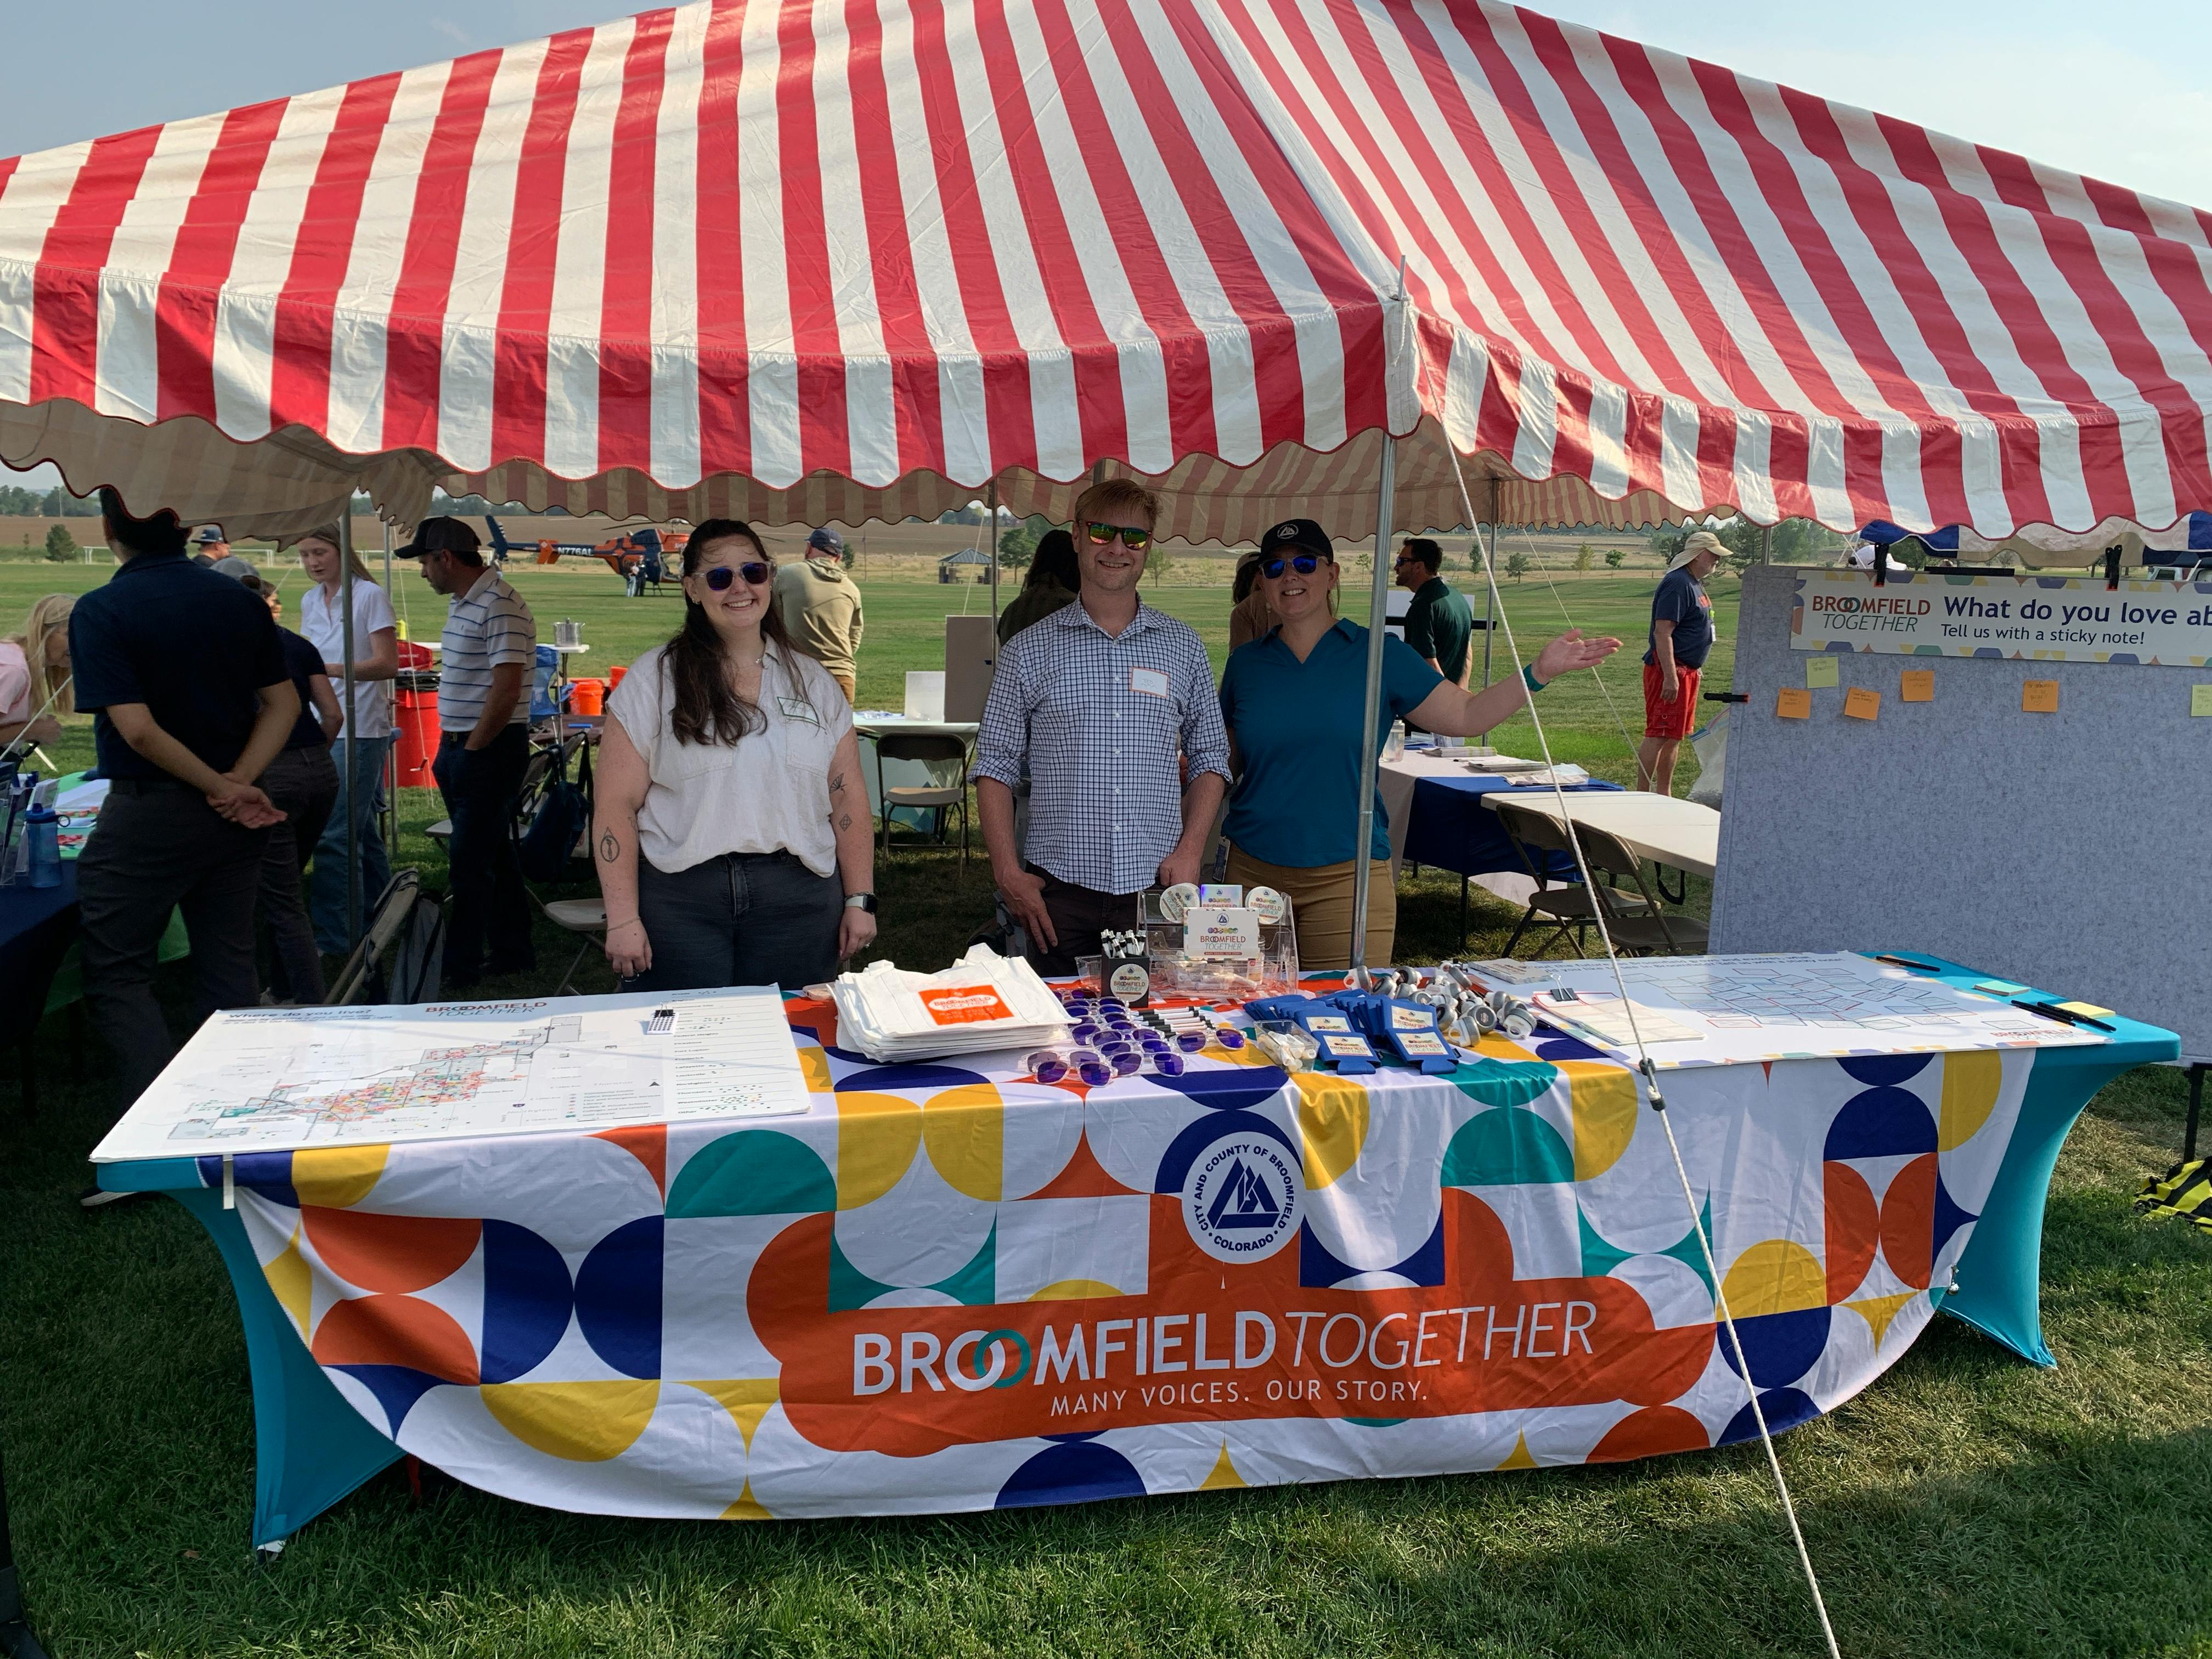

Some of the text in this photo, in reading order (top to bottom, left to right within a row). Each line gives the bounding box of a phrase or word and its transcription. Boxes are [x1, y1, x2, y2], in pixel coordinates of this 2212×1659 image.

[557, 546, 594, 557] N776AL
[1812, 595, 1931, 616] BROOMFIELD
[1944, 596, 2012, 619] What
[2021, 598, 2053, 621] do
[2061, 603, 2110, 628] you
[2121, 601, 2179, 625] love
[1822, 613, 1918, 633] TOGETHER
[1941, 624, 2145, 646] Tell us with a sticky note!
[425, 1002, 548, 1013] BROOMFIELD
[438, 1007, 535, 1017] TOGETHER
[1194, 1144, 1294, 1231] CITY AND COUNTY OF BROOMFIELD
[1213, 1233, 1274, 1251] COLORADO
[853, 1300, 1597, 1396] BROOMFIELD TOGETHER
[1050, 1379, 1427, 1417] MANY VOICES. OUR STORY.
